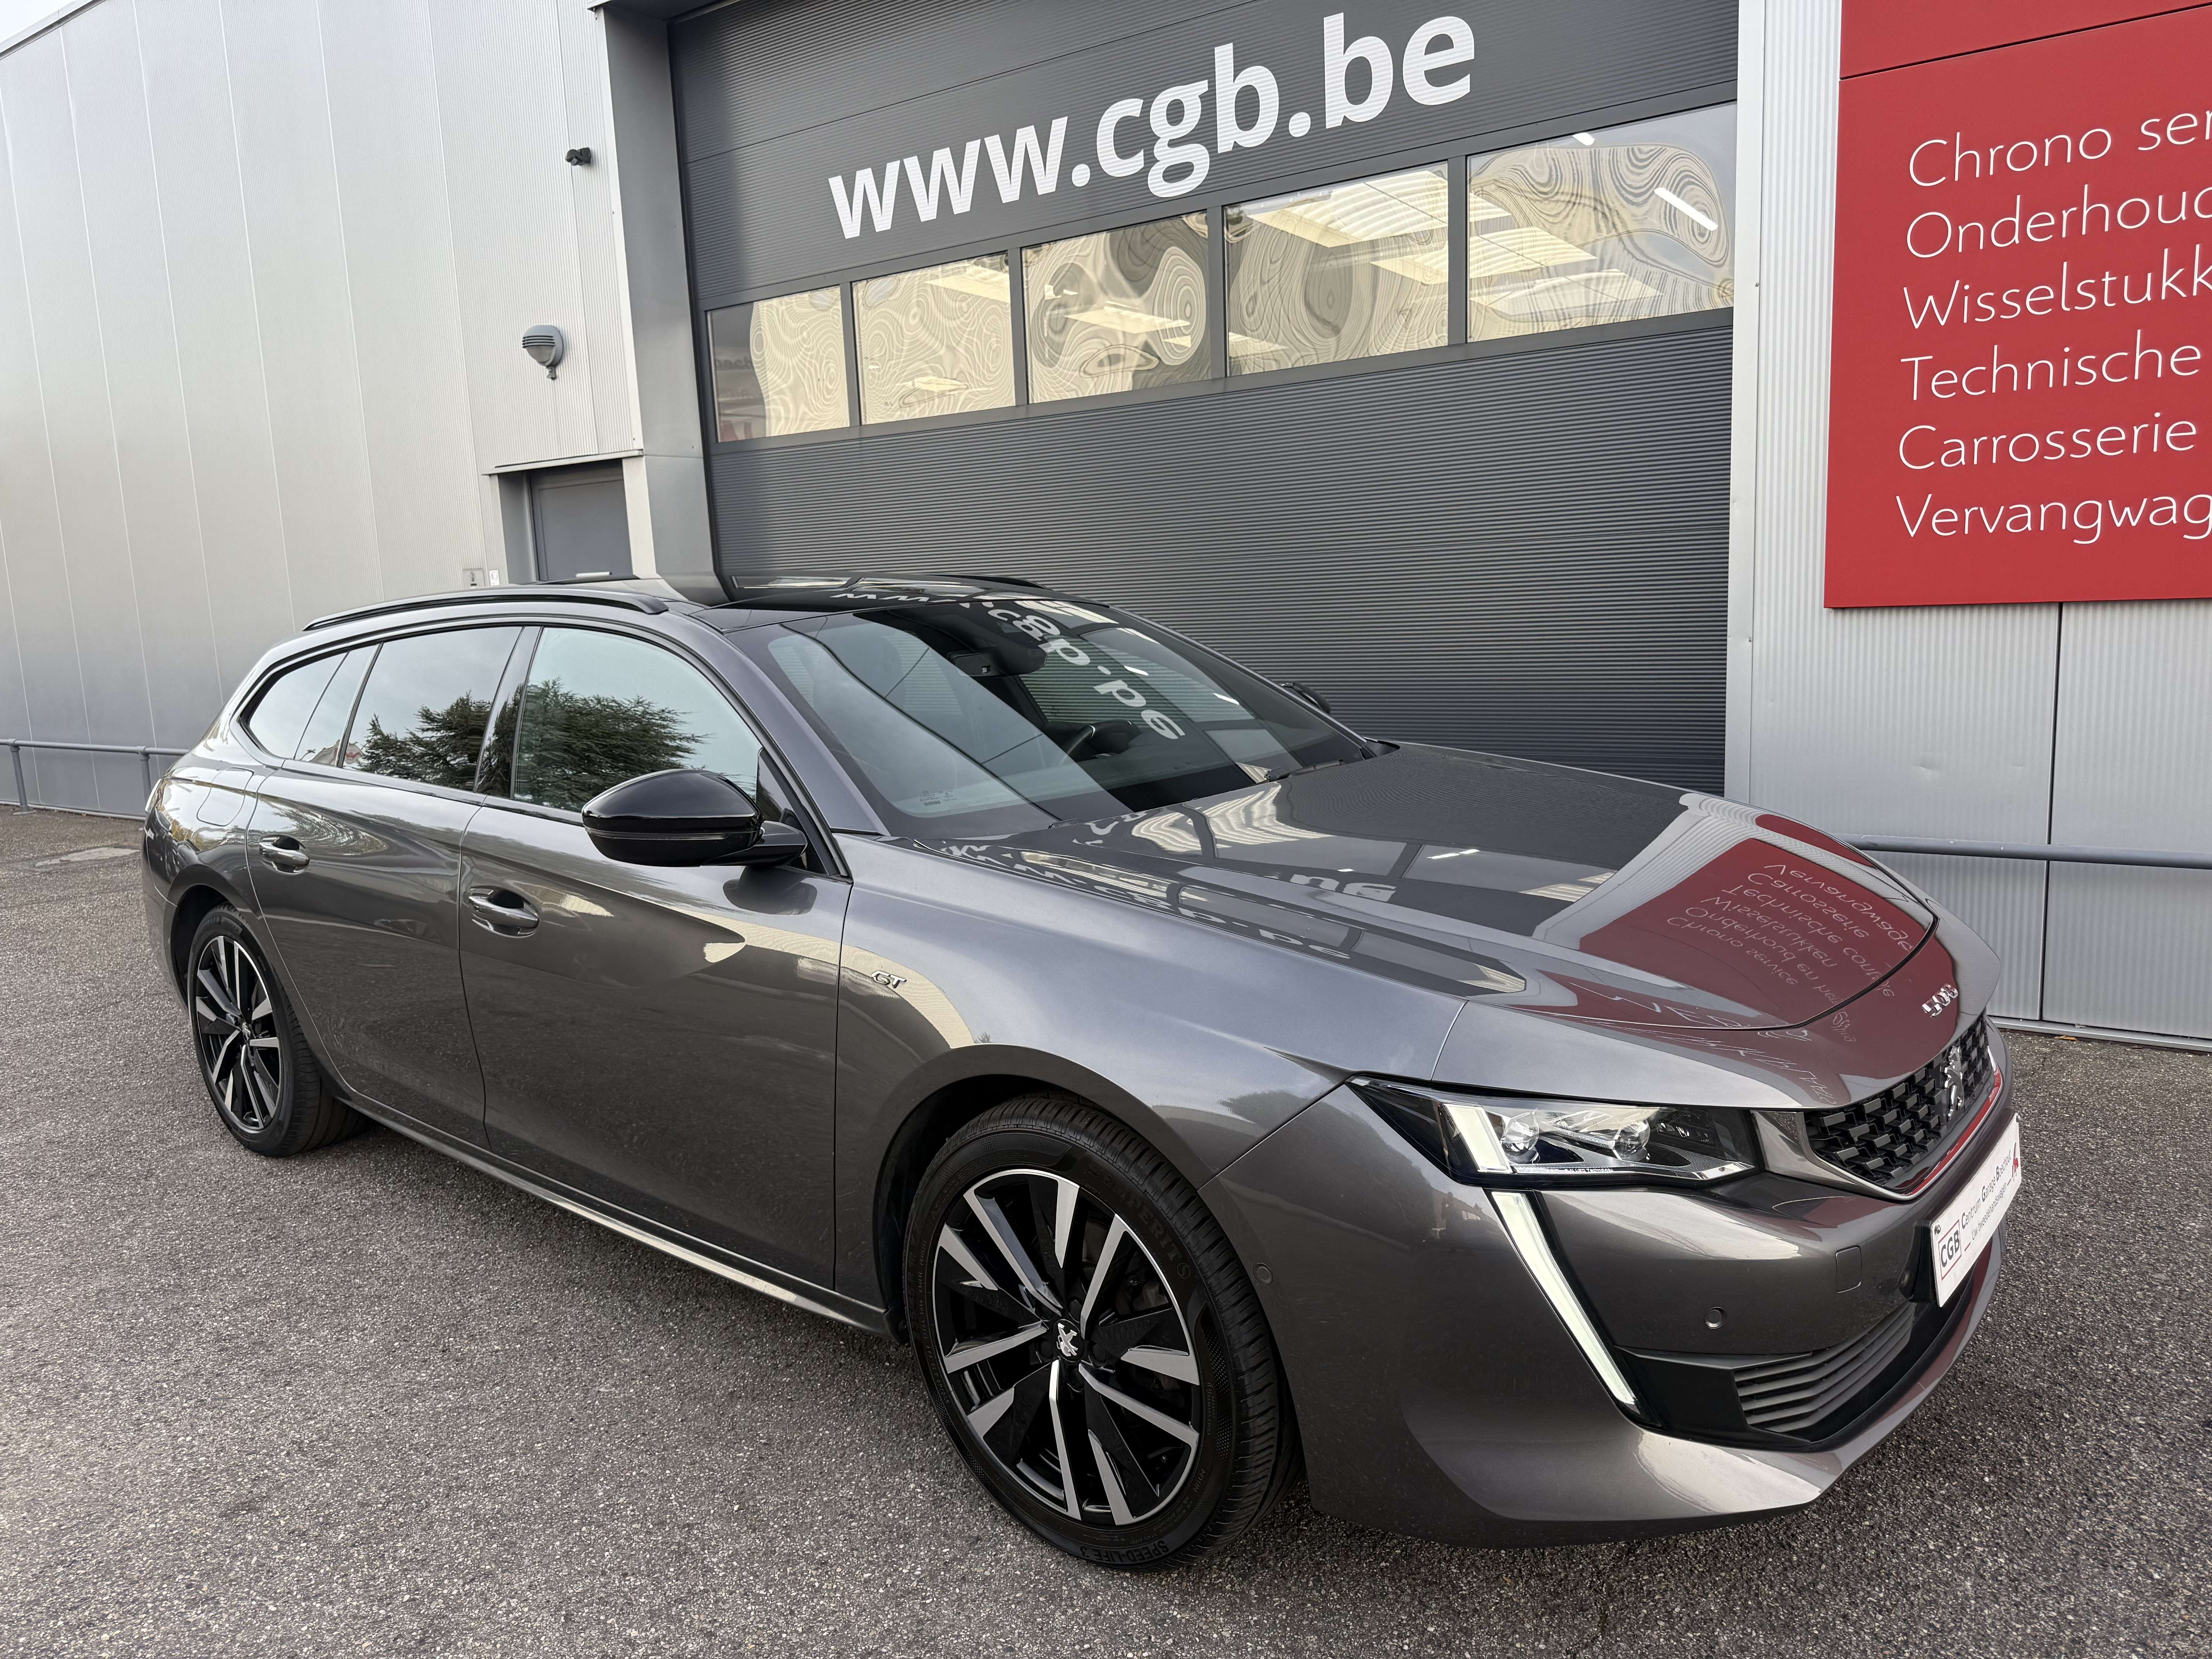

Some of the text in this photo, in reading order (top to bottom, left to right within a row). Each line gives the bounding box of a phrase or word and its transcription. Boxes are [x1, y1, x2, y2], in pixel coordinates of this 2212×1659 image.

[828, 13, 1474, 239] www.cgb.be
[1909, 129, 2112, 187] Chrono
[1903, 244, 2212, 329] Wisselstukk
[1900, 329, 2201, 400] Technische
[1899, 412, 2197, 469] Carrosserie
[1896, 494, 2212, 544] Vervangwag
[871, 970, 907, 988] GT
[1921, 983, 1958, 1018] 508
[1961, 1198, 1981, 1229] Centrum
[1982, 1176, 1996, 1202] Garage
[1940, 1230, 1960, 1267] CGB
[1094, 1540, 1169, 1563] SPEED-LIFE
